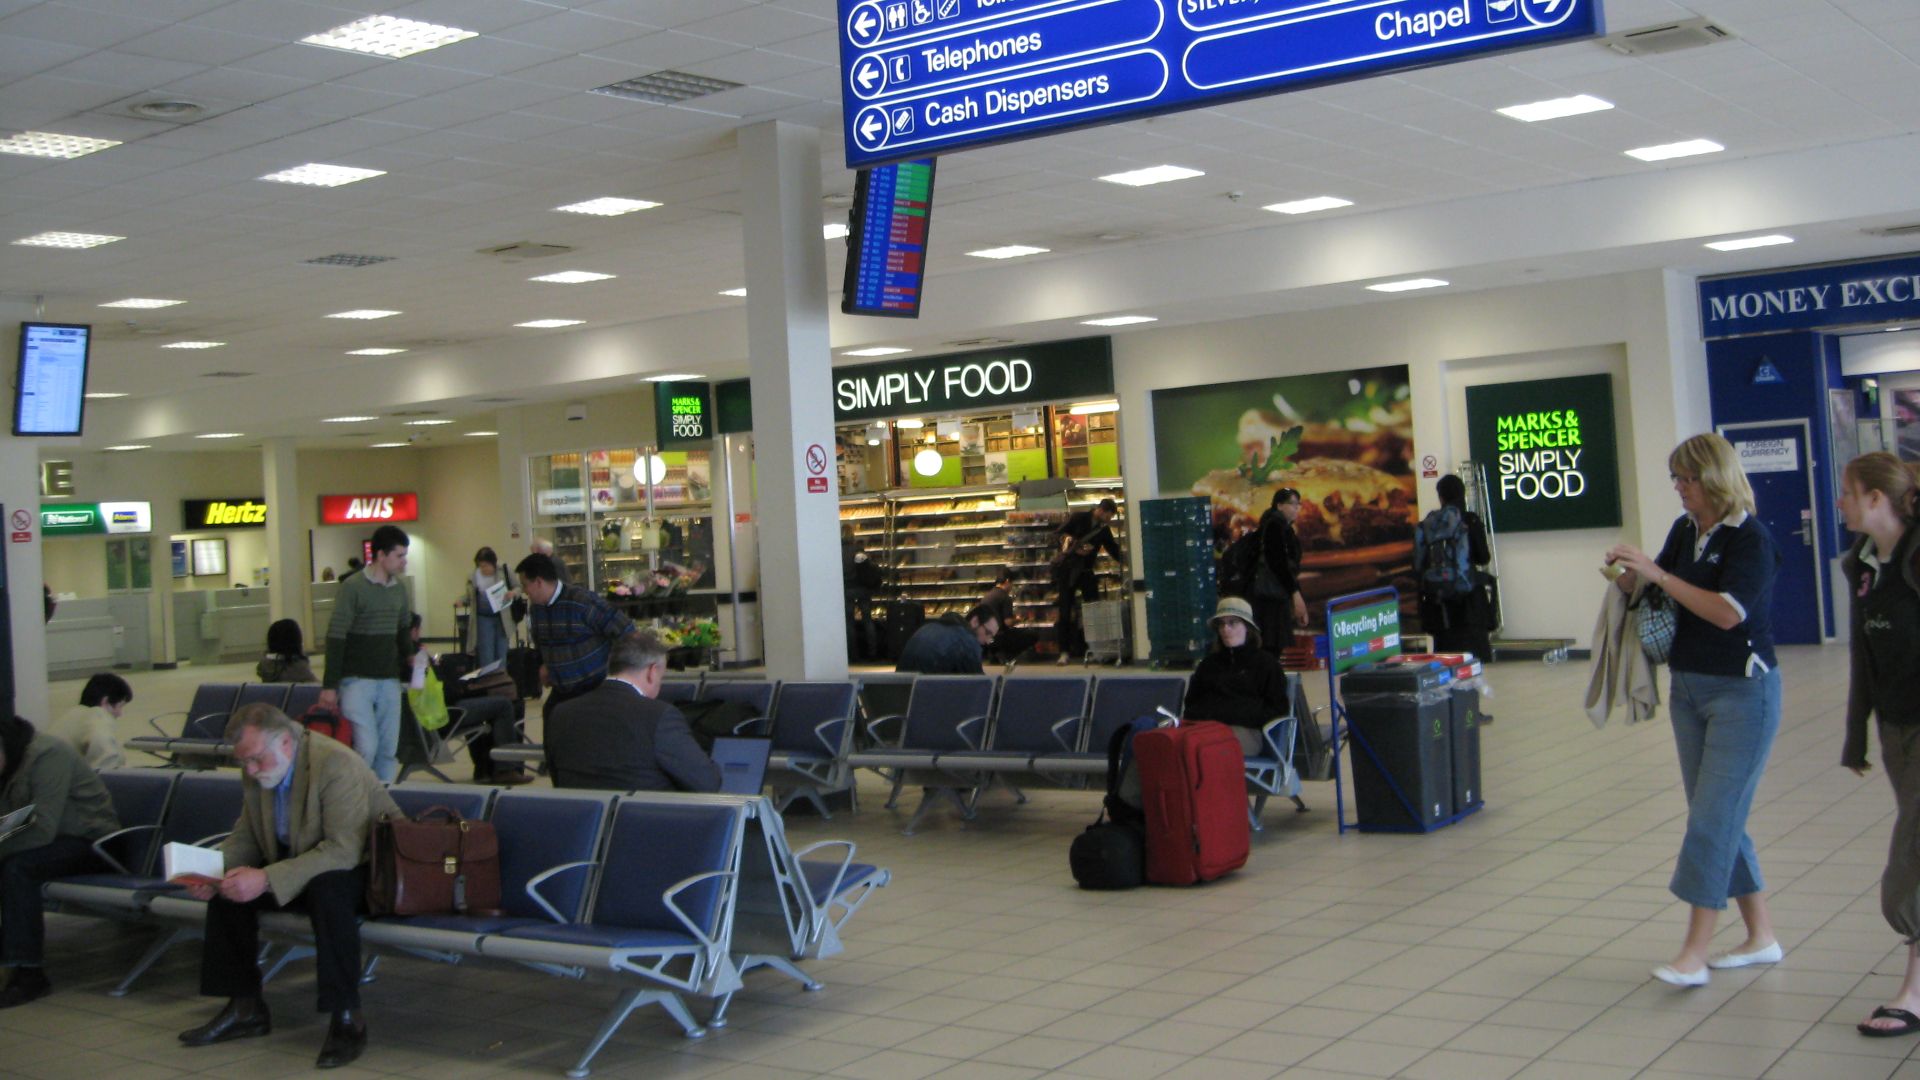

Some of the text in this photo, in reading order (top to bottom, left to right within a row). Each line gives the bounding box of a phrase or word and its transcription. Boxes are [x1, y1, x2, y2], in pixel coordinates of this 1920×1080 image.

[1375, 5, 1471, 41] Chapel
[921, 31, 1042, 73] Telephones
[925, 73, 1110, 126] Cash Dispensers
[1709, 285, 1830, 321] MONEY
[837, 359, 1033, 411] SIMPLY FOOD
[672, 397, 695, 406] MARKS
[672, 405, 702, 415] SPENCER
[672, 414, 702, 425] SIMPLY
[673, 424, 703, 437] FOOD
[1497, 409, 1579, 433] MARKS &
[1497, 428, 1582, 451] SPENCER
[1499, 449, 1582, 475] SIMPLY
[1740, 447, 1790, 458] CURRENCY
[1500, 470, 1585, 501] FOOD
[205, 501, 267, 525] Hertz
[346, 497, 394, 519] AVIS
[1340, 609, 1398, 637] Recycling Point
